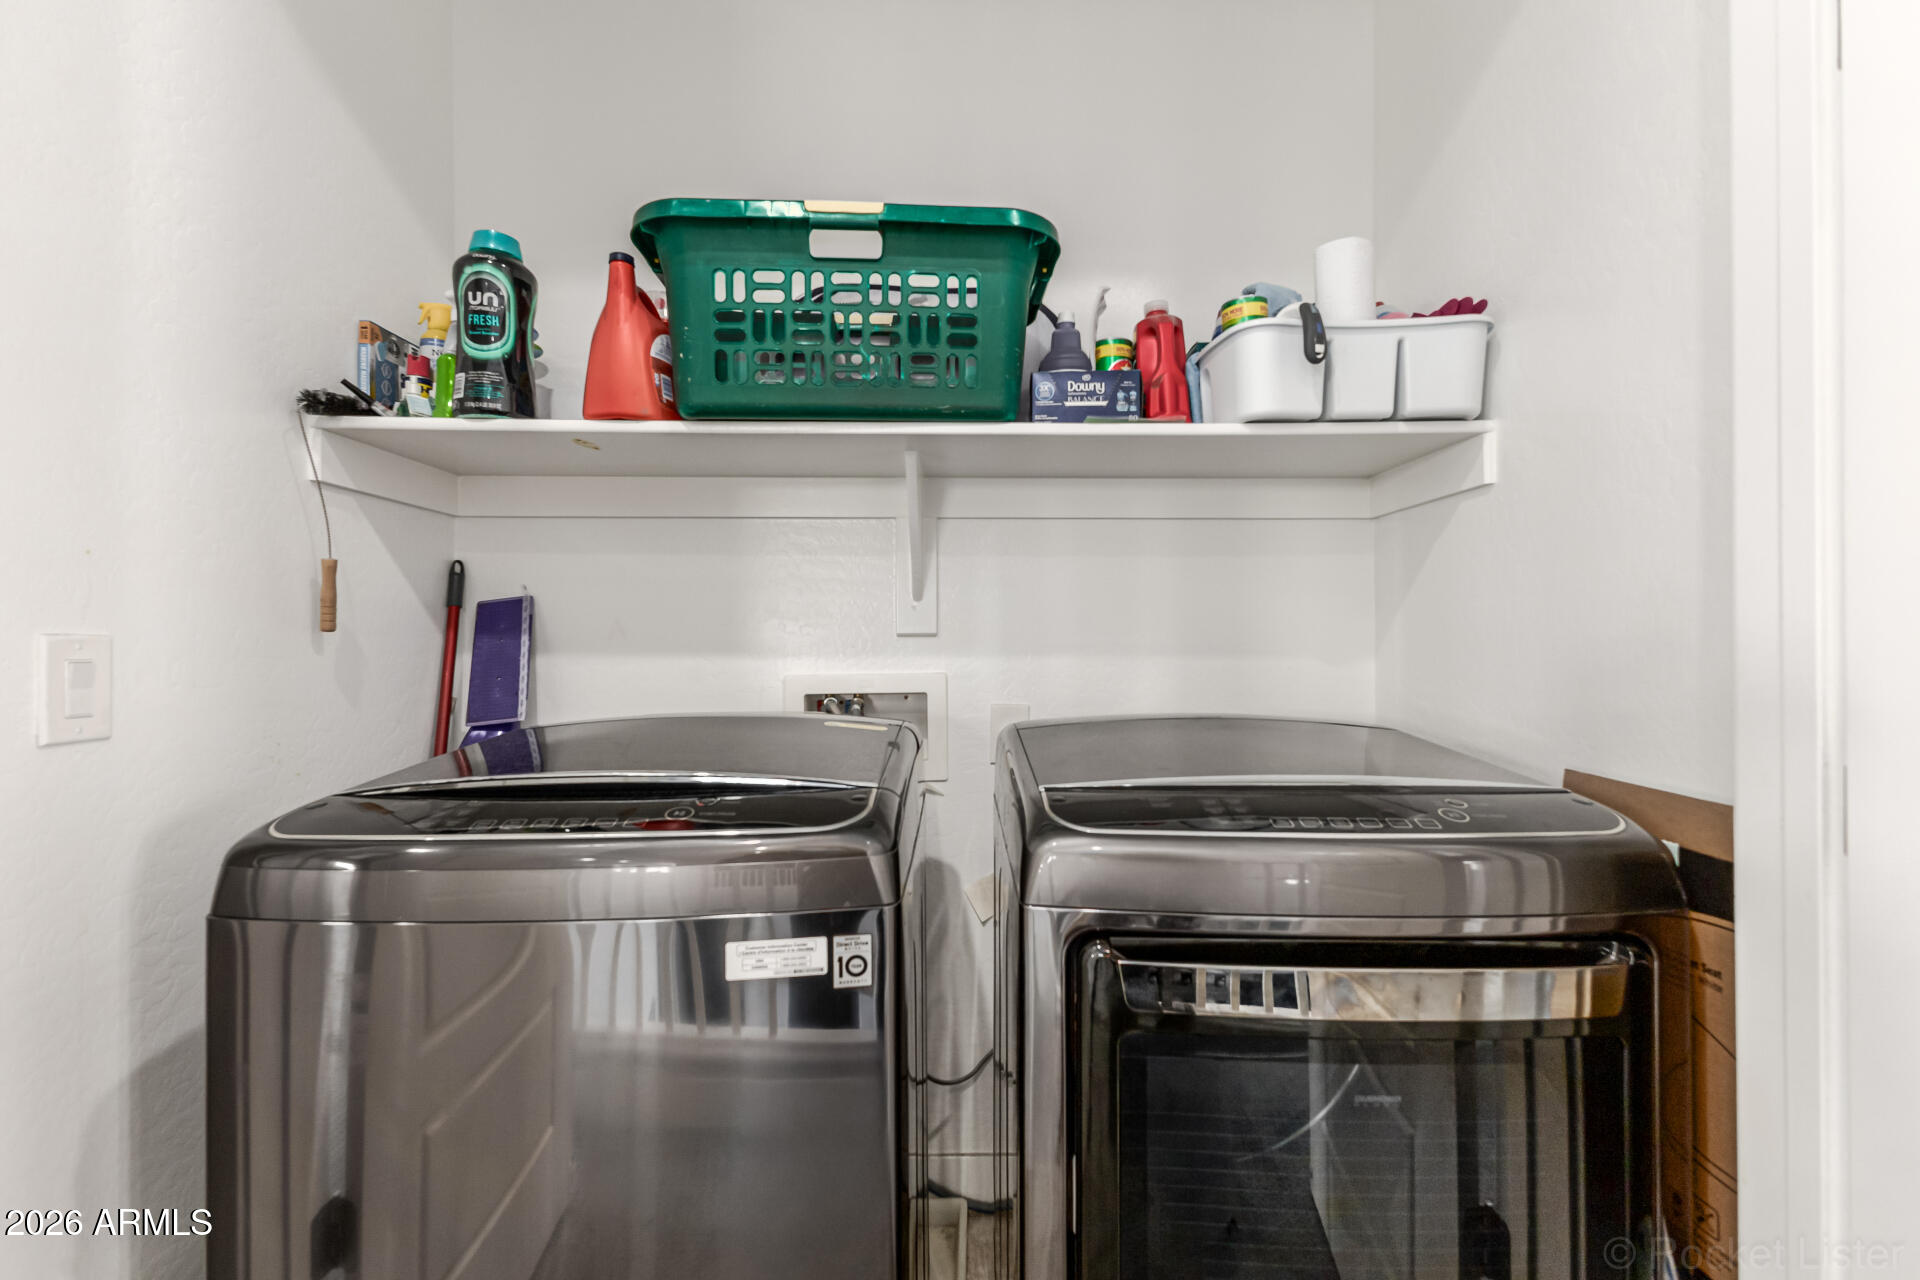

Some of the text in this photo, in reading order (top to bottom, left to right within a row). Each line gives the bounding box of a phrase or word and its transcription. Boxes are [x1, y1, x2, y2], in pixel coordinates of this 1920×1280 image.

[467, 314, 500, 327] FRESH
[1067, 381, 1105, 394] Downy
[837, 955, 868, 978] 10
